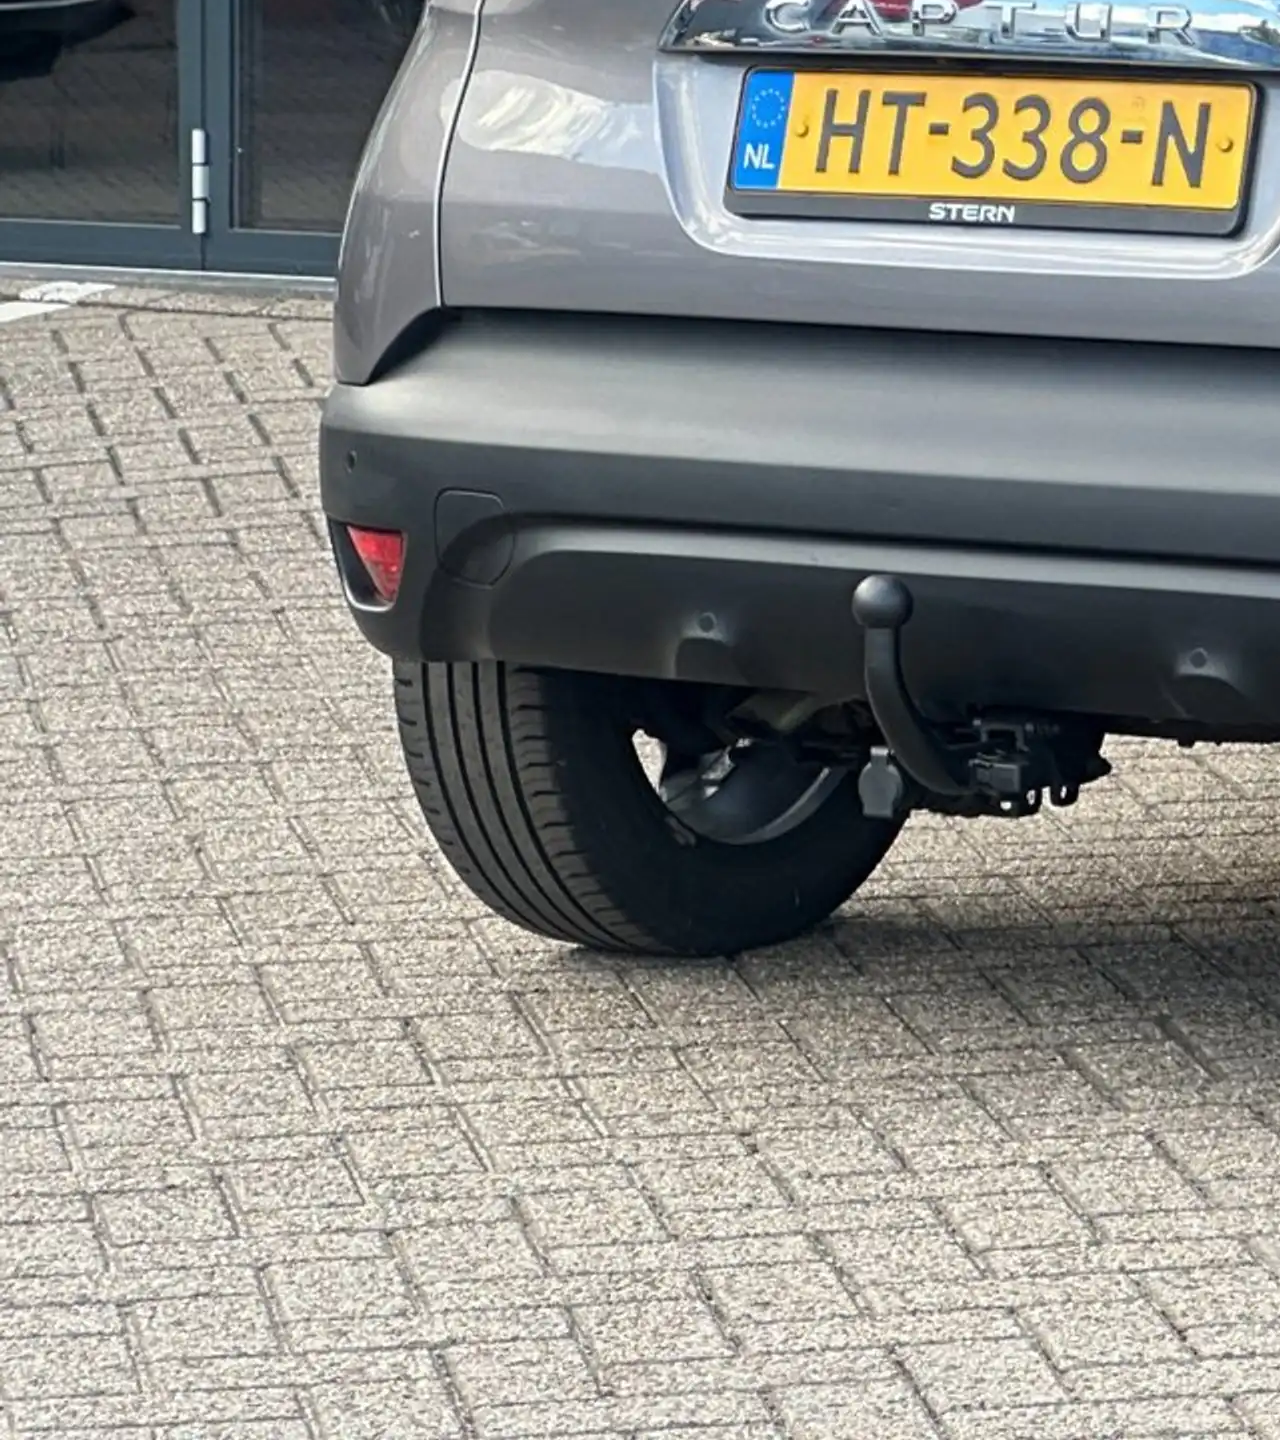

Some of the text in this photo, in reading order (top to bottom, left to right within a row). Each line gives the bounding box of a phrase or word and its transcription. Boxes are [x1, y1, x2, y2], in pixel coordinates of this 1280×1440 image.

[815, 87, 1212, 189] HT-338-N
[743, 142, 776, 170] NL
[928, 203, 1015, 224] STERN
